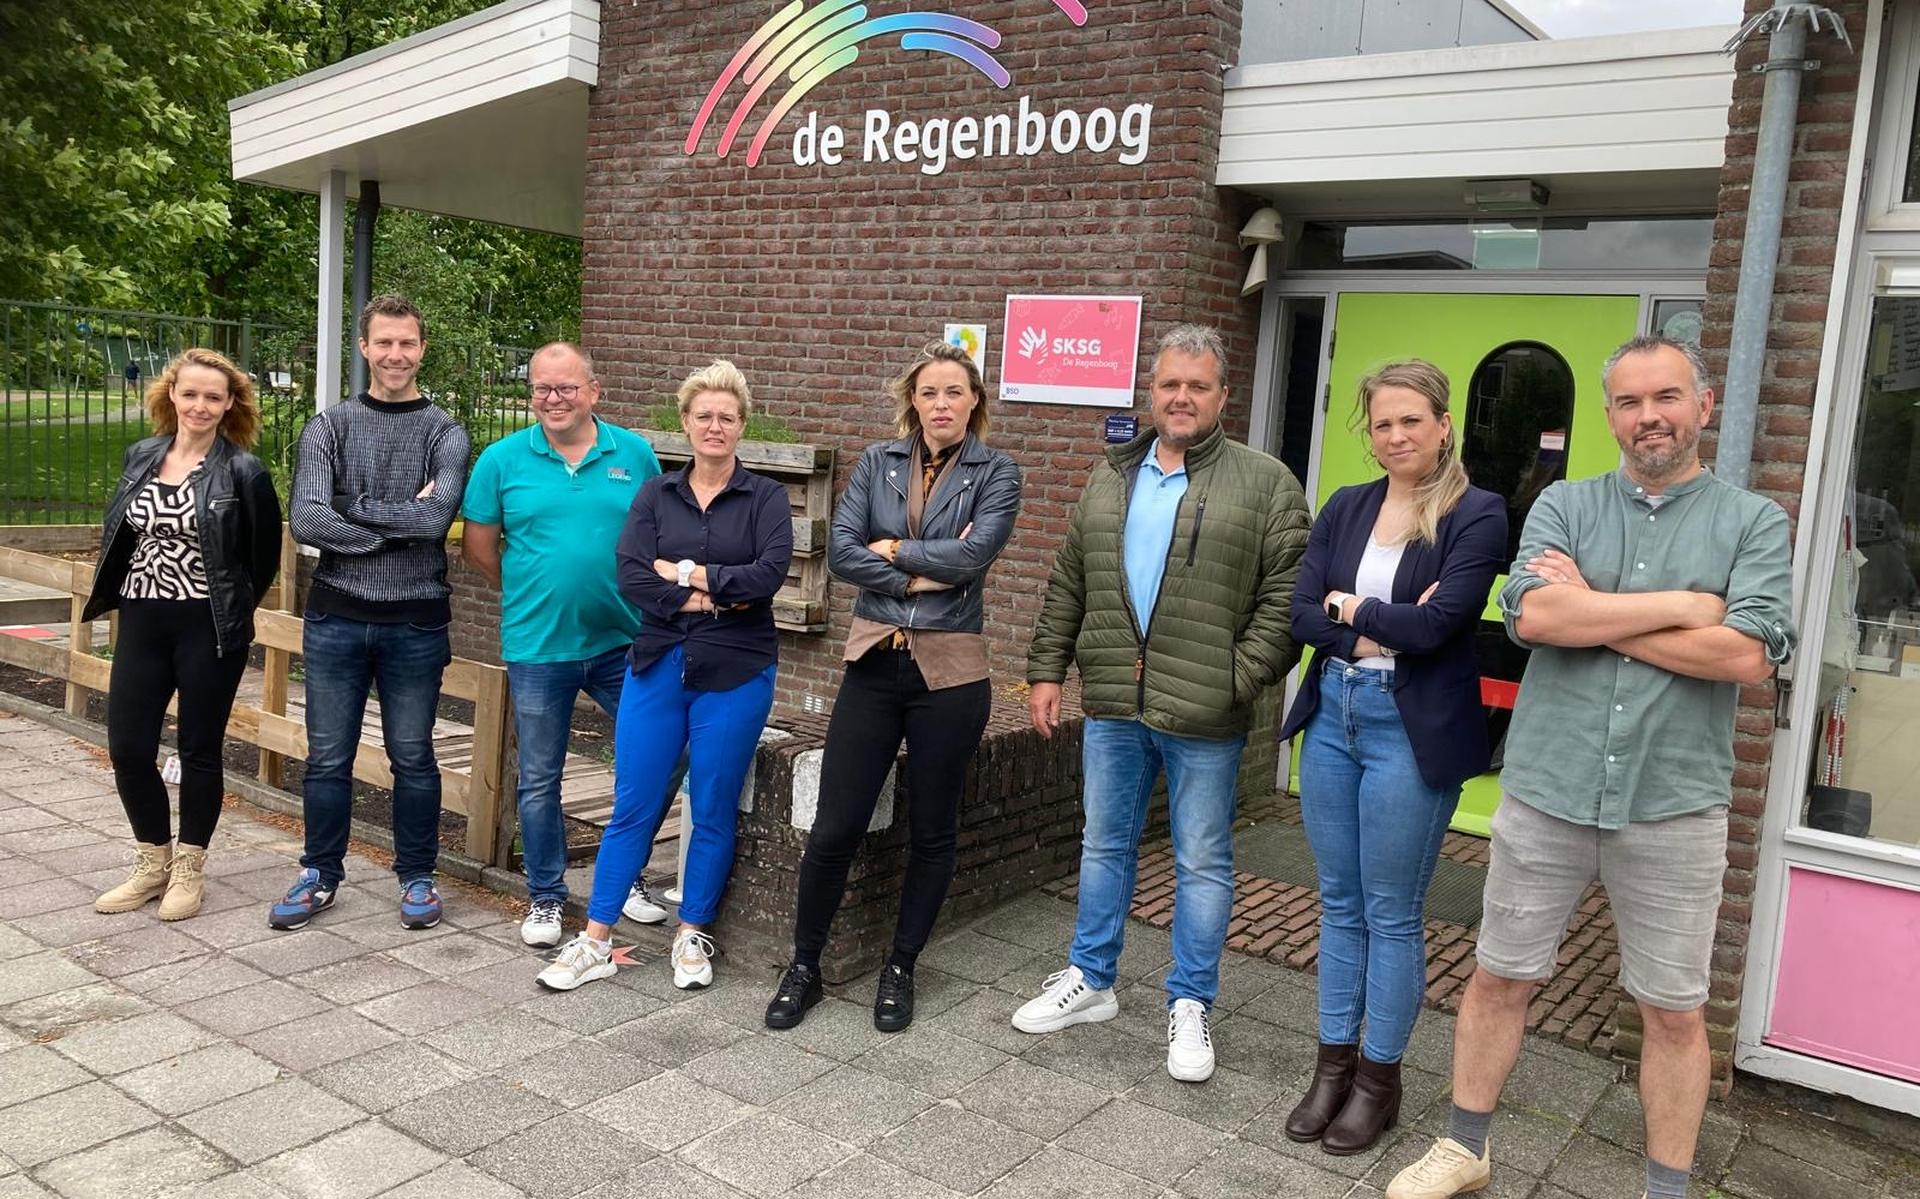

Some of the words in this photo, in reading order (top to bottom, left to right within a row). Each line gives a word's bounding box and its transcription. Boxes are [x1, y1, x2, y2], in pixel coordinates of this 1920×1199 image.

[793, 110, 845, 167] de
[863, 95, 1154, 176] Regenboog
[1053, 337, 1102, 356] SKSG
[1063, 357, 1073, 366] De
[1075, 358, 1118, 370] Regenboog
